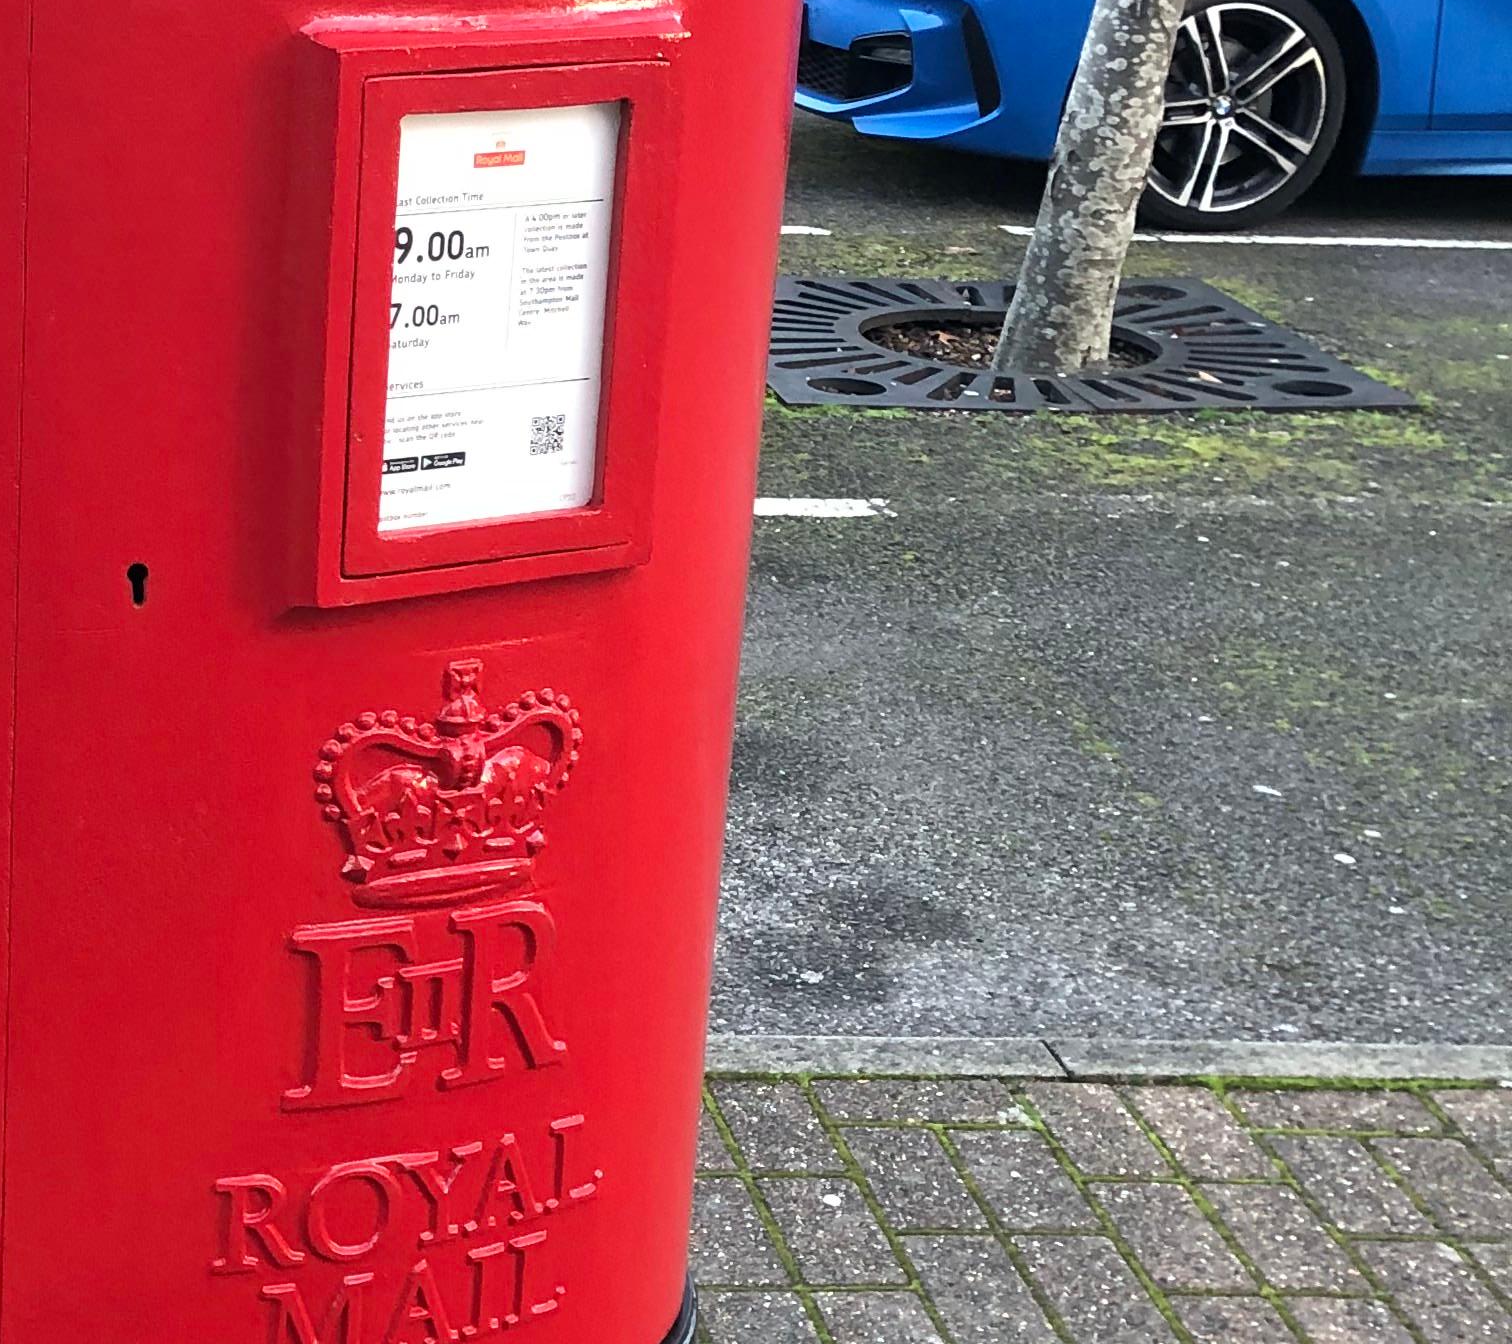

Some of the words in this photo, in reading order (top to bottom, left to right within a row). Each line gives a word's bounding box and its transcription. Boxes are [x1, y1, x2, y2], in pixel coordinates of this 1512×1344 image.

[476, 154, 501, 166] Royal
[504, 152, 524, 164] Mail
[396, 197, 413, 207] ast
[415, 195, 459, 206] Collection
[461, 192, 484, 201] Time
[394, 227, 490, 264] 9.00am
[431, 272, 441, 281] to
[445, 269, 476, 281] Friday
[389, 303, 460, 330] 7.00am
[390, 338, 430, 350] aturday
[388, 381, 424, 392] ervices
[210, 1113, 604, 1274] ROYAL
